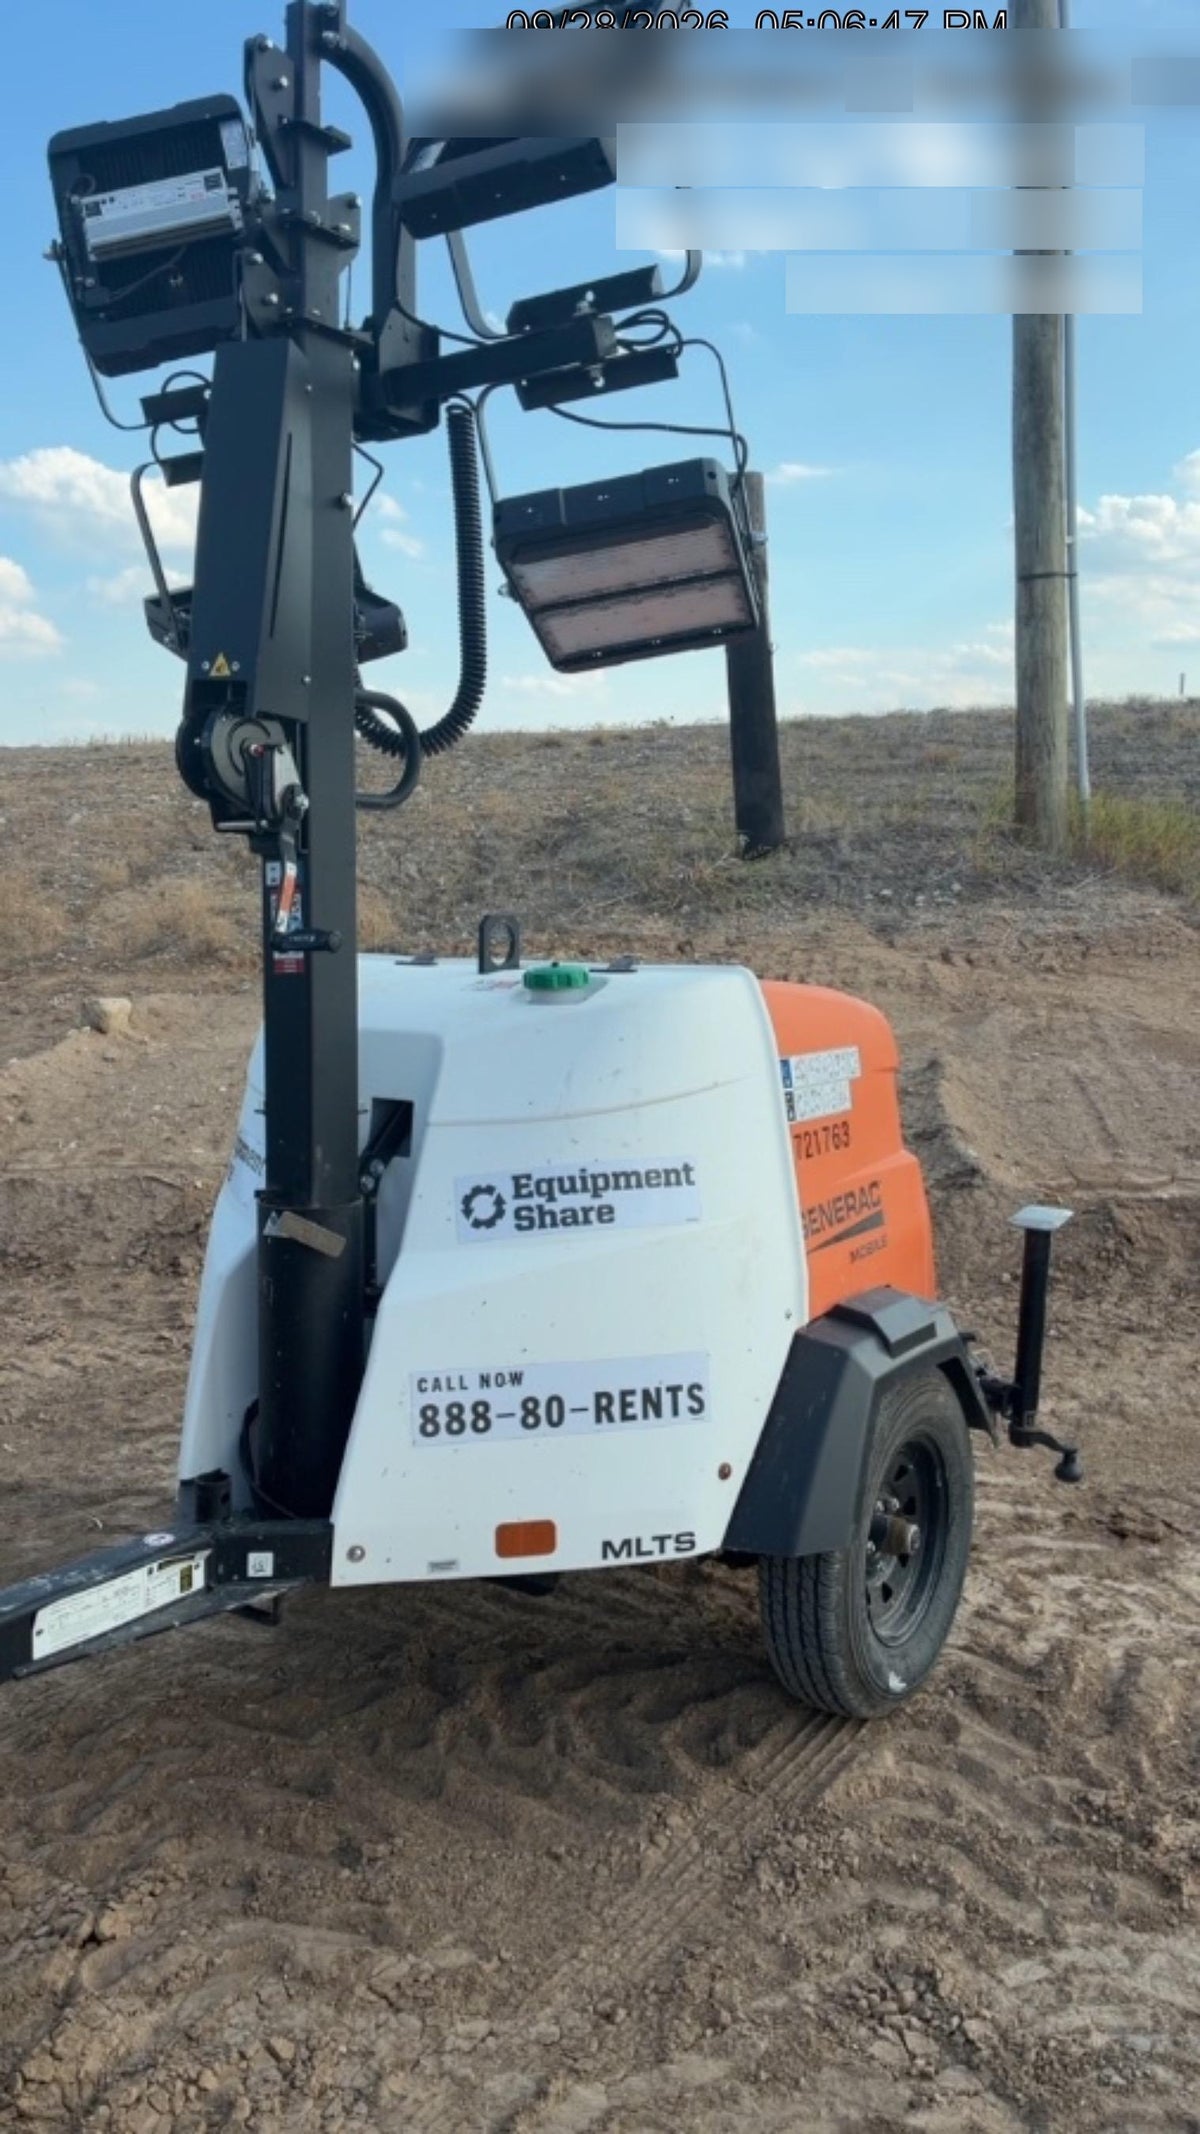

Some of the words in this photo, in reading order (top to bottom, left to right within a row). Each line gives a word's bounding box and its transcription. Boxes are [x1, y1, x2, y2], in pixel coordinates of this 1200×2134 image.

[793, 1120, 851, 1160] 721763
[511, 1161, 696, 1203] Equipment
[513, 1203, 615, 1231] Share
[417, 1374, 469, 1393] CALL
[478, 1370, 525, 1389] NOW
[418, 1383, 706, 1438] 888-80-RENTS
[601, 1531, 697, 1561] MLTS
